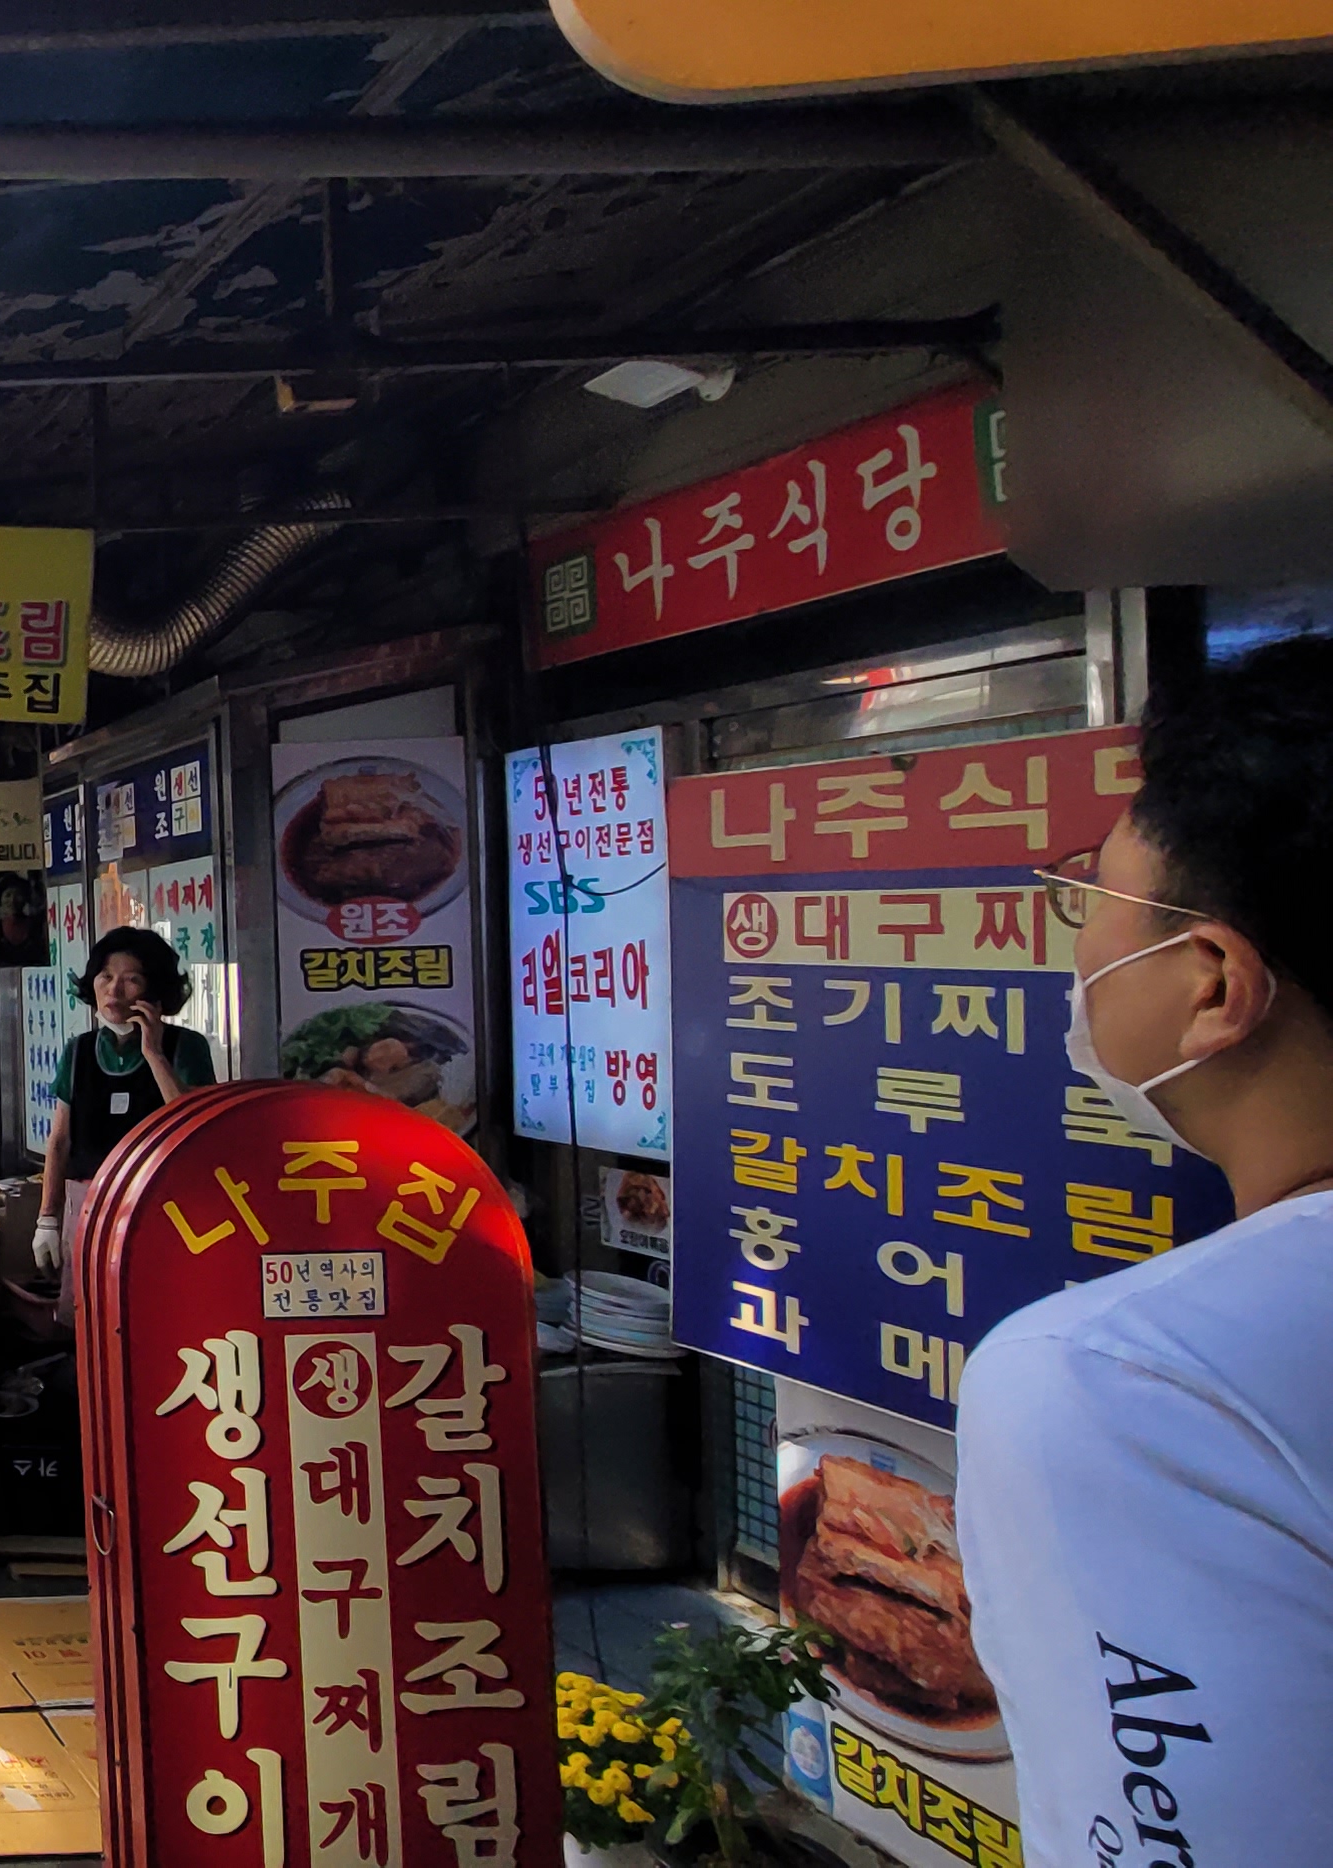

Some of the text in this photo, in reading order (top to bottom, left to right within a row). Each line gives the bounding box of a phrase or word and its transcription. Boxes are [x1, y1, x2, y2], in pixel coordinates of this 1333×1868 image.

[614, 425, 937, 621] 나주식당
[533, 766, 631, 822] 5년전통
[338, 903, 410, 939] 원조
[524, 877, 606, 916] SBS
[303, 947, 450, 988] 갈치조림
[725, 975, 1069, 1056] 조기찌
[605, 1049, 659, 1112] 방영
[162, 1139, 482, 1265] 나주집
[729, 1128, 1175, 1263] 갈치조림
[265, 1258, 375, 1285] 50년 역사의
[155, 1329, 288, 1868] 생선구이
[384, 1323, 525, 1868] 갈치조림
